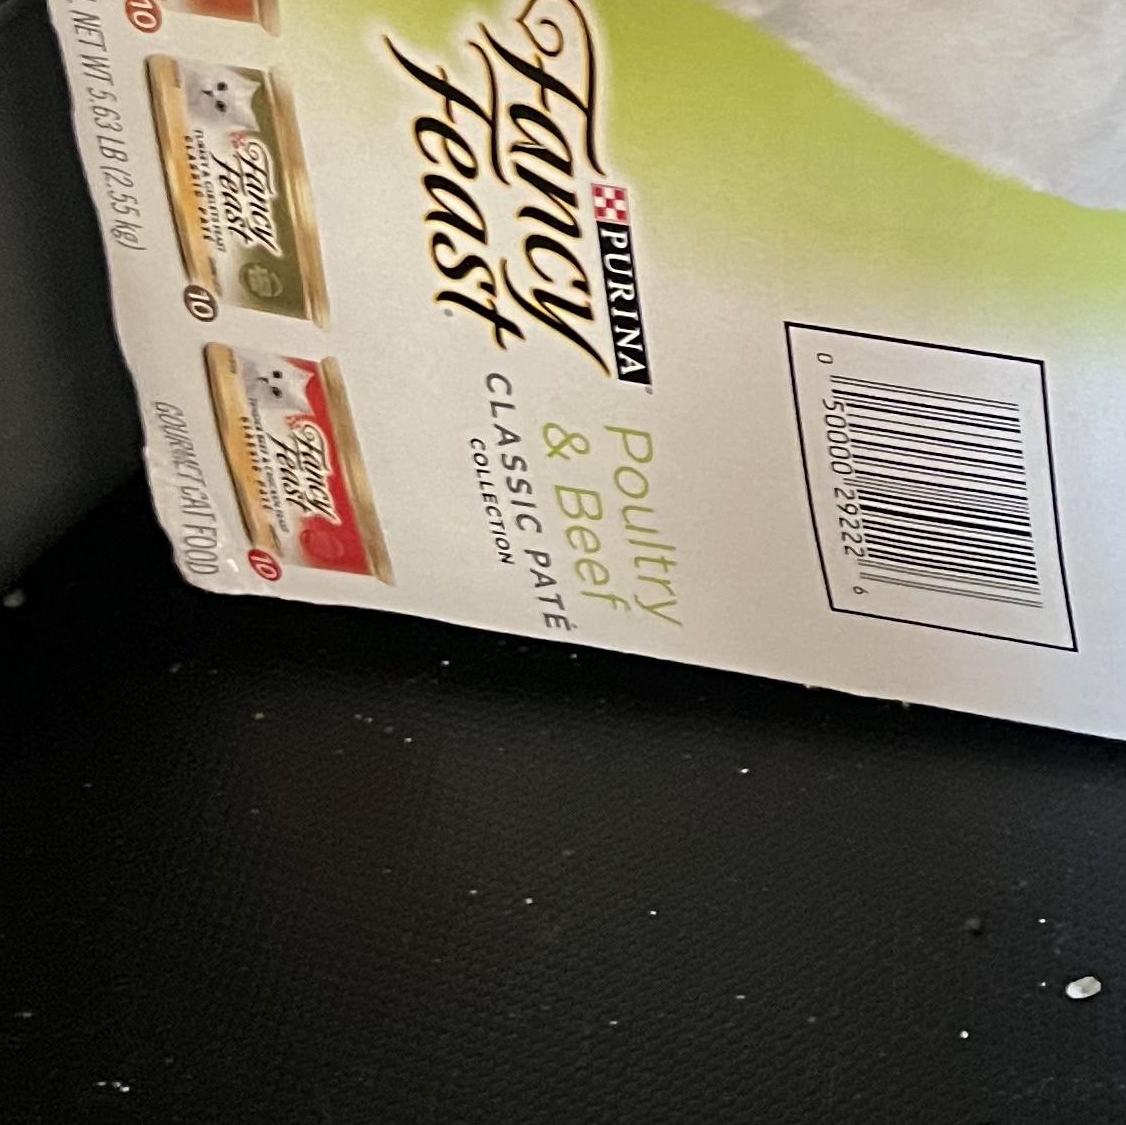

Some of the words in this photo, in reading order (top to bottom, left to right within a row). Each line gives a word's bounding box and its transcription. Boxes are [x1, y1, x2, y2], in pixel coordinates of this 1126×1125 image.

[70, 11, 105, 52] NET
[81, 52, 112, 87] WT
[88, 87, 123, 130] 5.63
[97, 135, 129, 160] LB
[100, 166, 140, 215] (2.55
[211, 152, 251, 243] Feast
[238, 143, 279, 251] Fancy
[383, 36, 525, 349] Feast
[112, 220, 146, 252] kg)
[188, 291, 210, 318] 10
[600, 227, 645, 376] PURINA
[817, 353, 834, 364] 0
[154, 402, 206, 485] GOURMET
[297, 425, 337, 518] Fancy
[543, 422, 588, 460] &
[822, 398, 853, 476] 50000
[178, 485, 213, 524] CAT
[268, 434, 308, 513] Feast
[470, 438, 514, 565] COLLECTION
[486, 372, 541, 534] CLASSIC
[524, 549, 571, 632] PATÉ
[185, 524, 219, 575] FOOD
[553, 486, 629, 610] Beef
[604, 425, 683, 627] Poultry
[834, 487, 865, 558] 29222
[251, 555, 276, 578] 10
